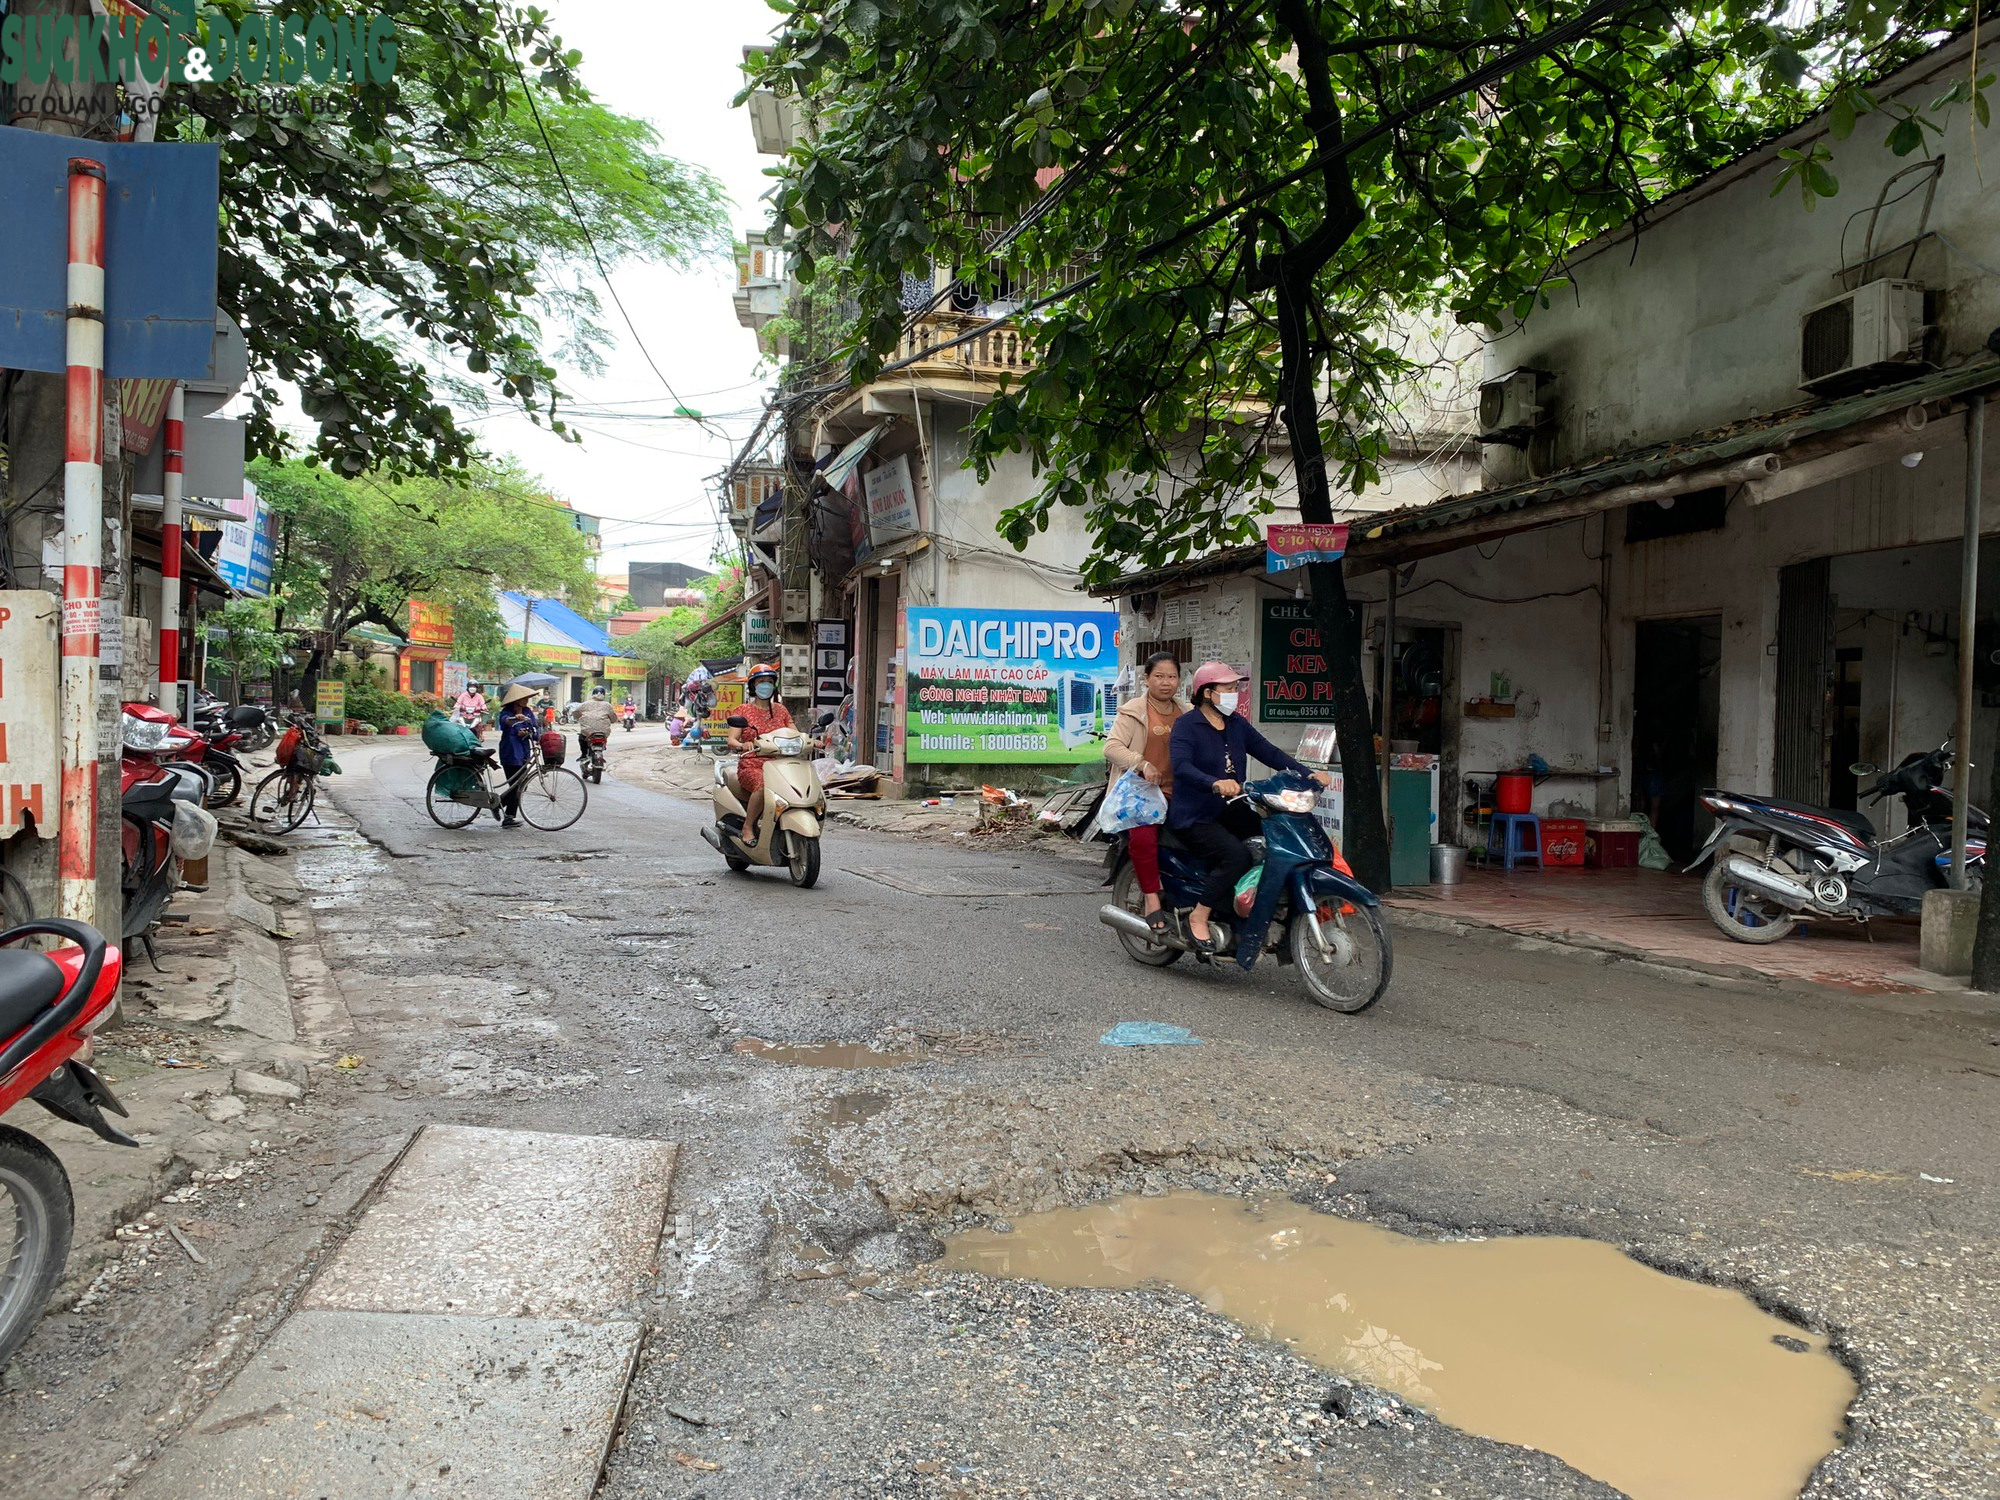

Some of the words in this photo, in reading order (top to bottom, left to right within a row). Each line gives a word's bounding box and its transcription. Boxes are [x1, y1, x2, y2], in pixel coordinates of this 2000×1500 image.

[1308, 526, 1334, 537] ngày
[918, 617, 1102, 660] DAICHIPRO
[920, 664, 944, 679] MÁY
[948, 664, 971, 679] LÀM
[974, 665, 997, 680] MÁT
[1000, 668, 1024, 680] CAO
[1026, 665, 1049, 681] CẤP
[920, 684, 954, 702] CÔNG
[955, 685, 988, 704] NGHỆ
[990, 686, 1021, 704] NHẬT
[1263, 675, 1307, 700] TÀO
[920, 709, 949, 725] Web:
[951, 711, 1049, 727] www.daichipro.vn
[1300, 706, 1318, 716] 0356
[980, 735, 1047, 751] 18006583
